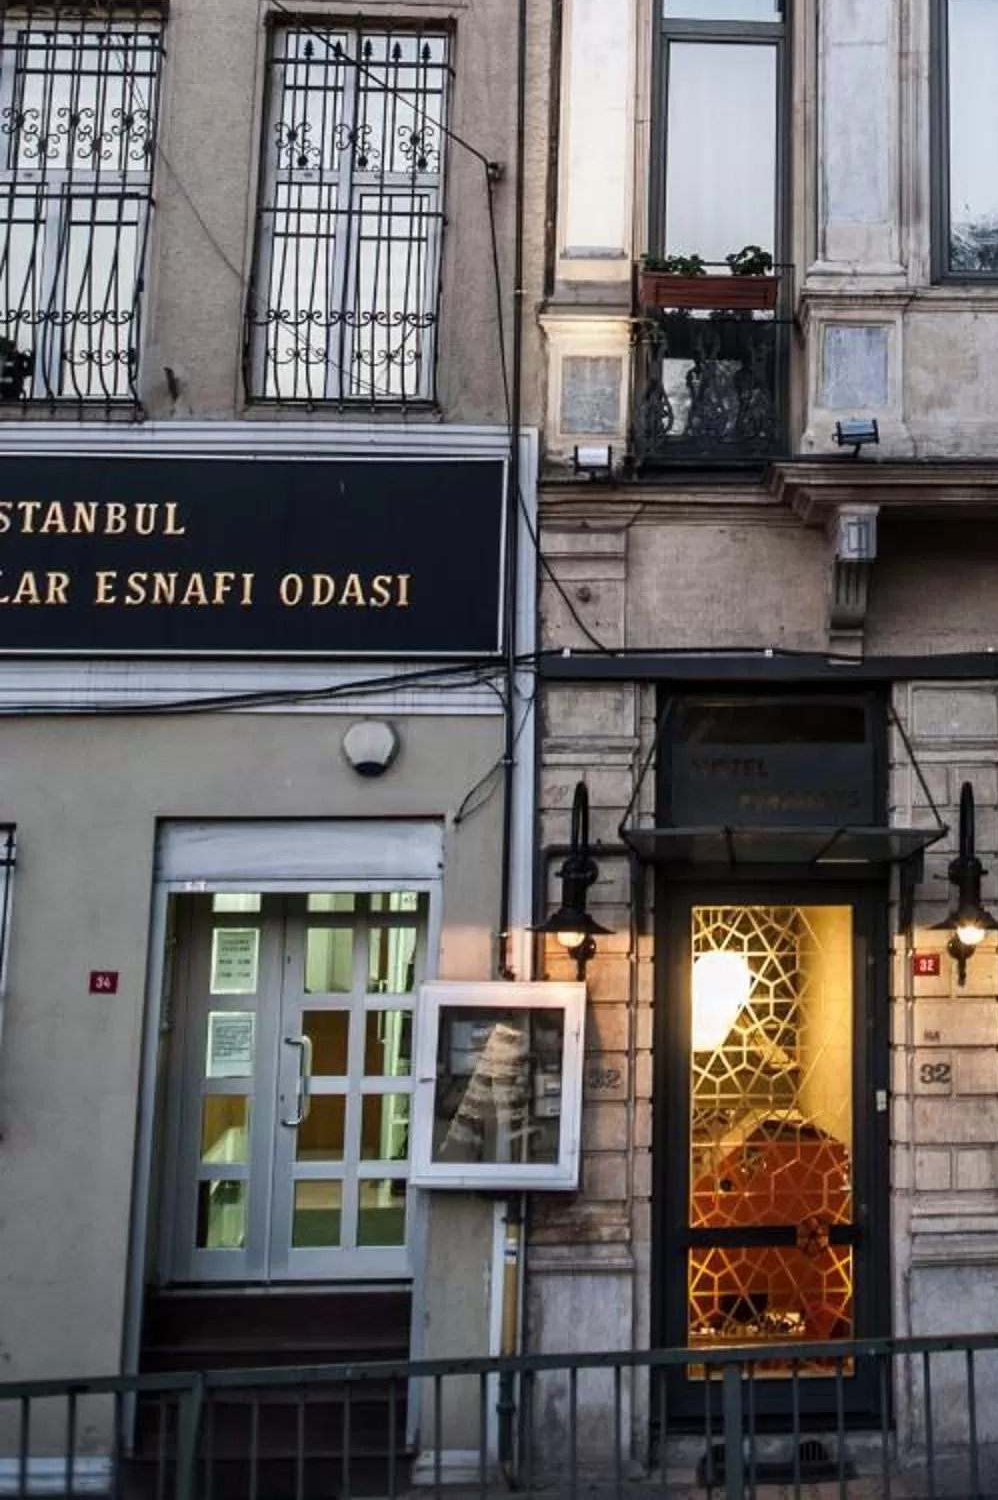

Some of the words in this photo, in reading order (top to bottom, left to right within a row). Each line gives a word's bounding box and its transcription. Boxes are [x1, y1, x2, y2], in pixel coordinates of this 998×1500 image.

[0, 501, 186, 535] STANBUL
[95, 571, 255, 605] ESNAFI
[280, 573, 411, 606] ODASI
[919, 959, 935, 972] 32
[920, 1063, 951, 1085] 32
